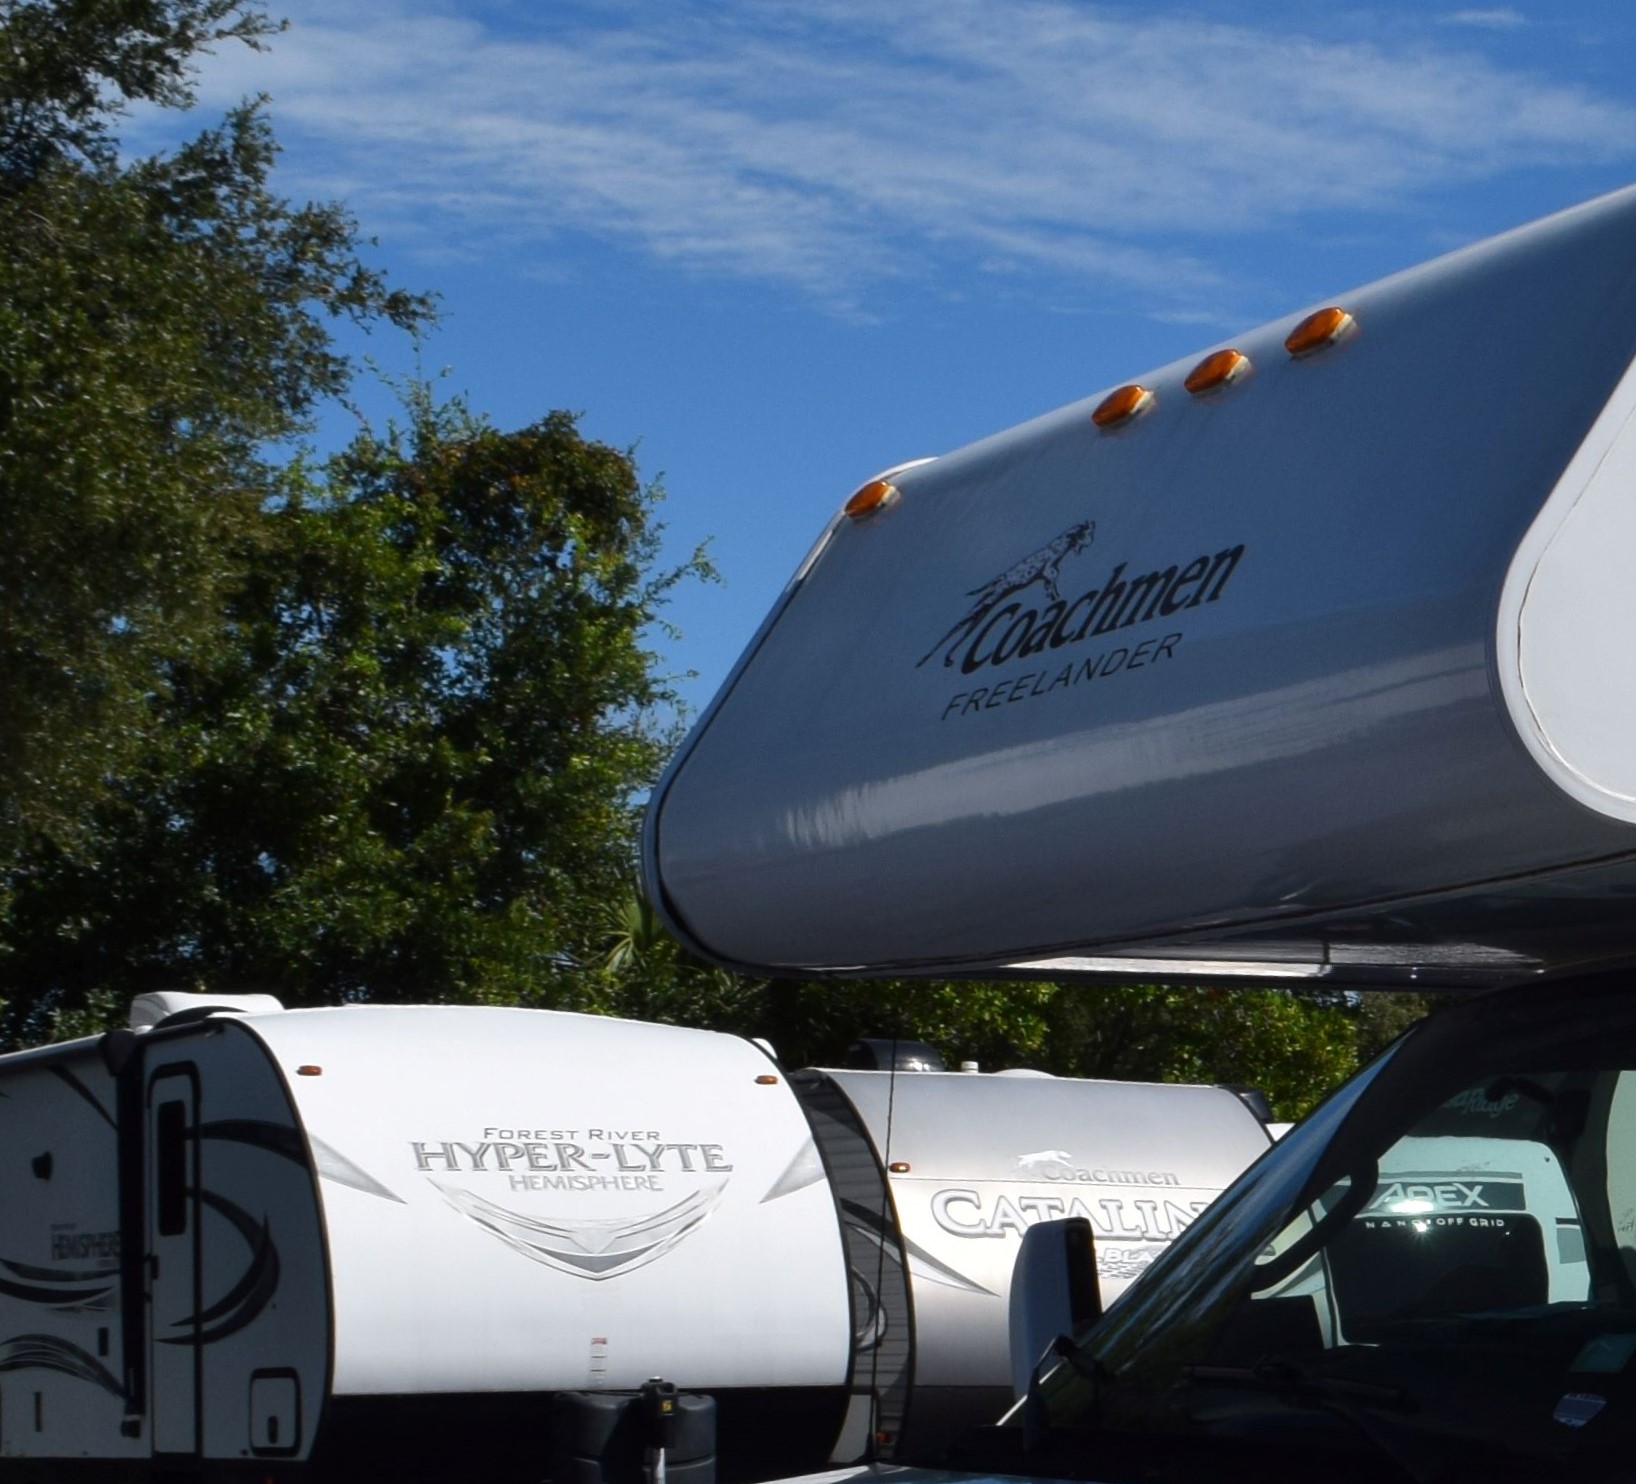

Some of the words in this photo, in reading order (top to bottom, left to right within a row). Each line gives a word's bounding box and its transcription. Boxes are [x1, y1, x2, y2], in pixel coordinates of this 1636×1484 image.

[961, 543, 1245, 675] Coachmen
[941, 633, 1183, 720] FREELANDER
[484, 1127, 579, 1141] FOREST
[588, 1128, 661, 1142] RIVER
[410, 1140, 735, 1173] HYPER-LYTE
[509, 1174, 665, 1193] HEMISPHERE
[1041, 1164, 1182, 1187] Coachmen
[930, 1188, 1210, 1242] CATALIN
[1436, 1217, 1464, 1226] OFF
[1468, 1217, 1506, 1228] GRID
